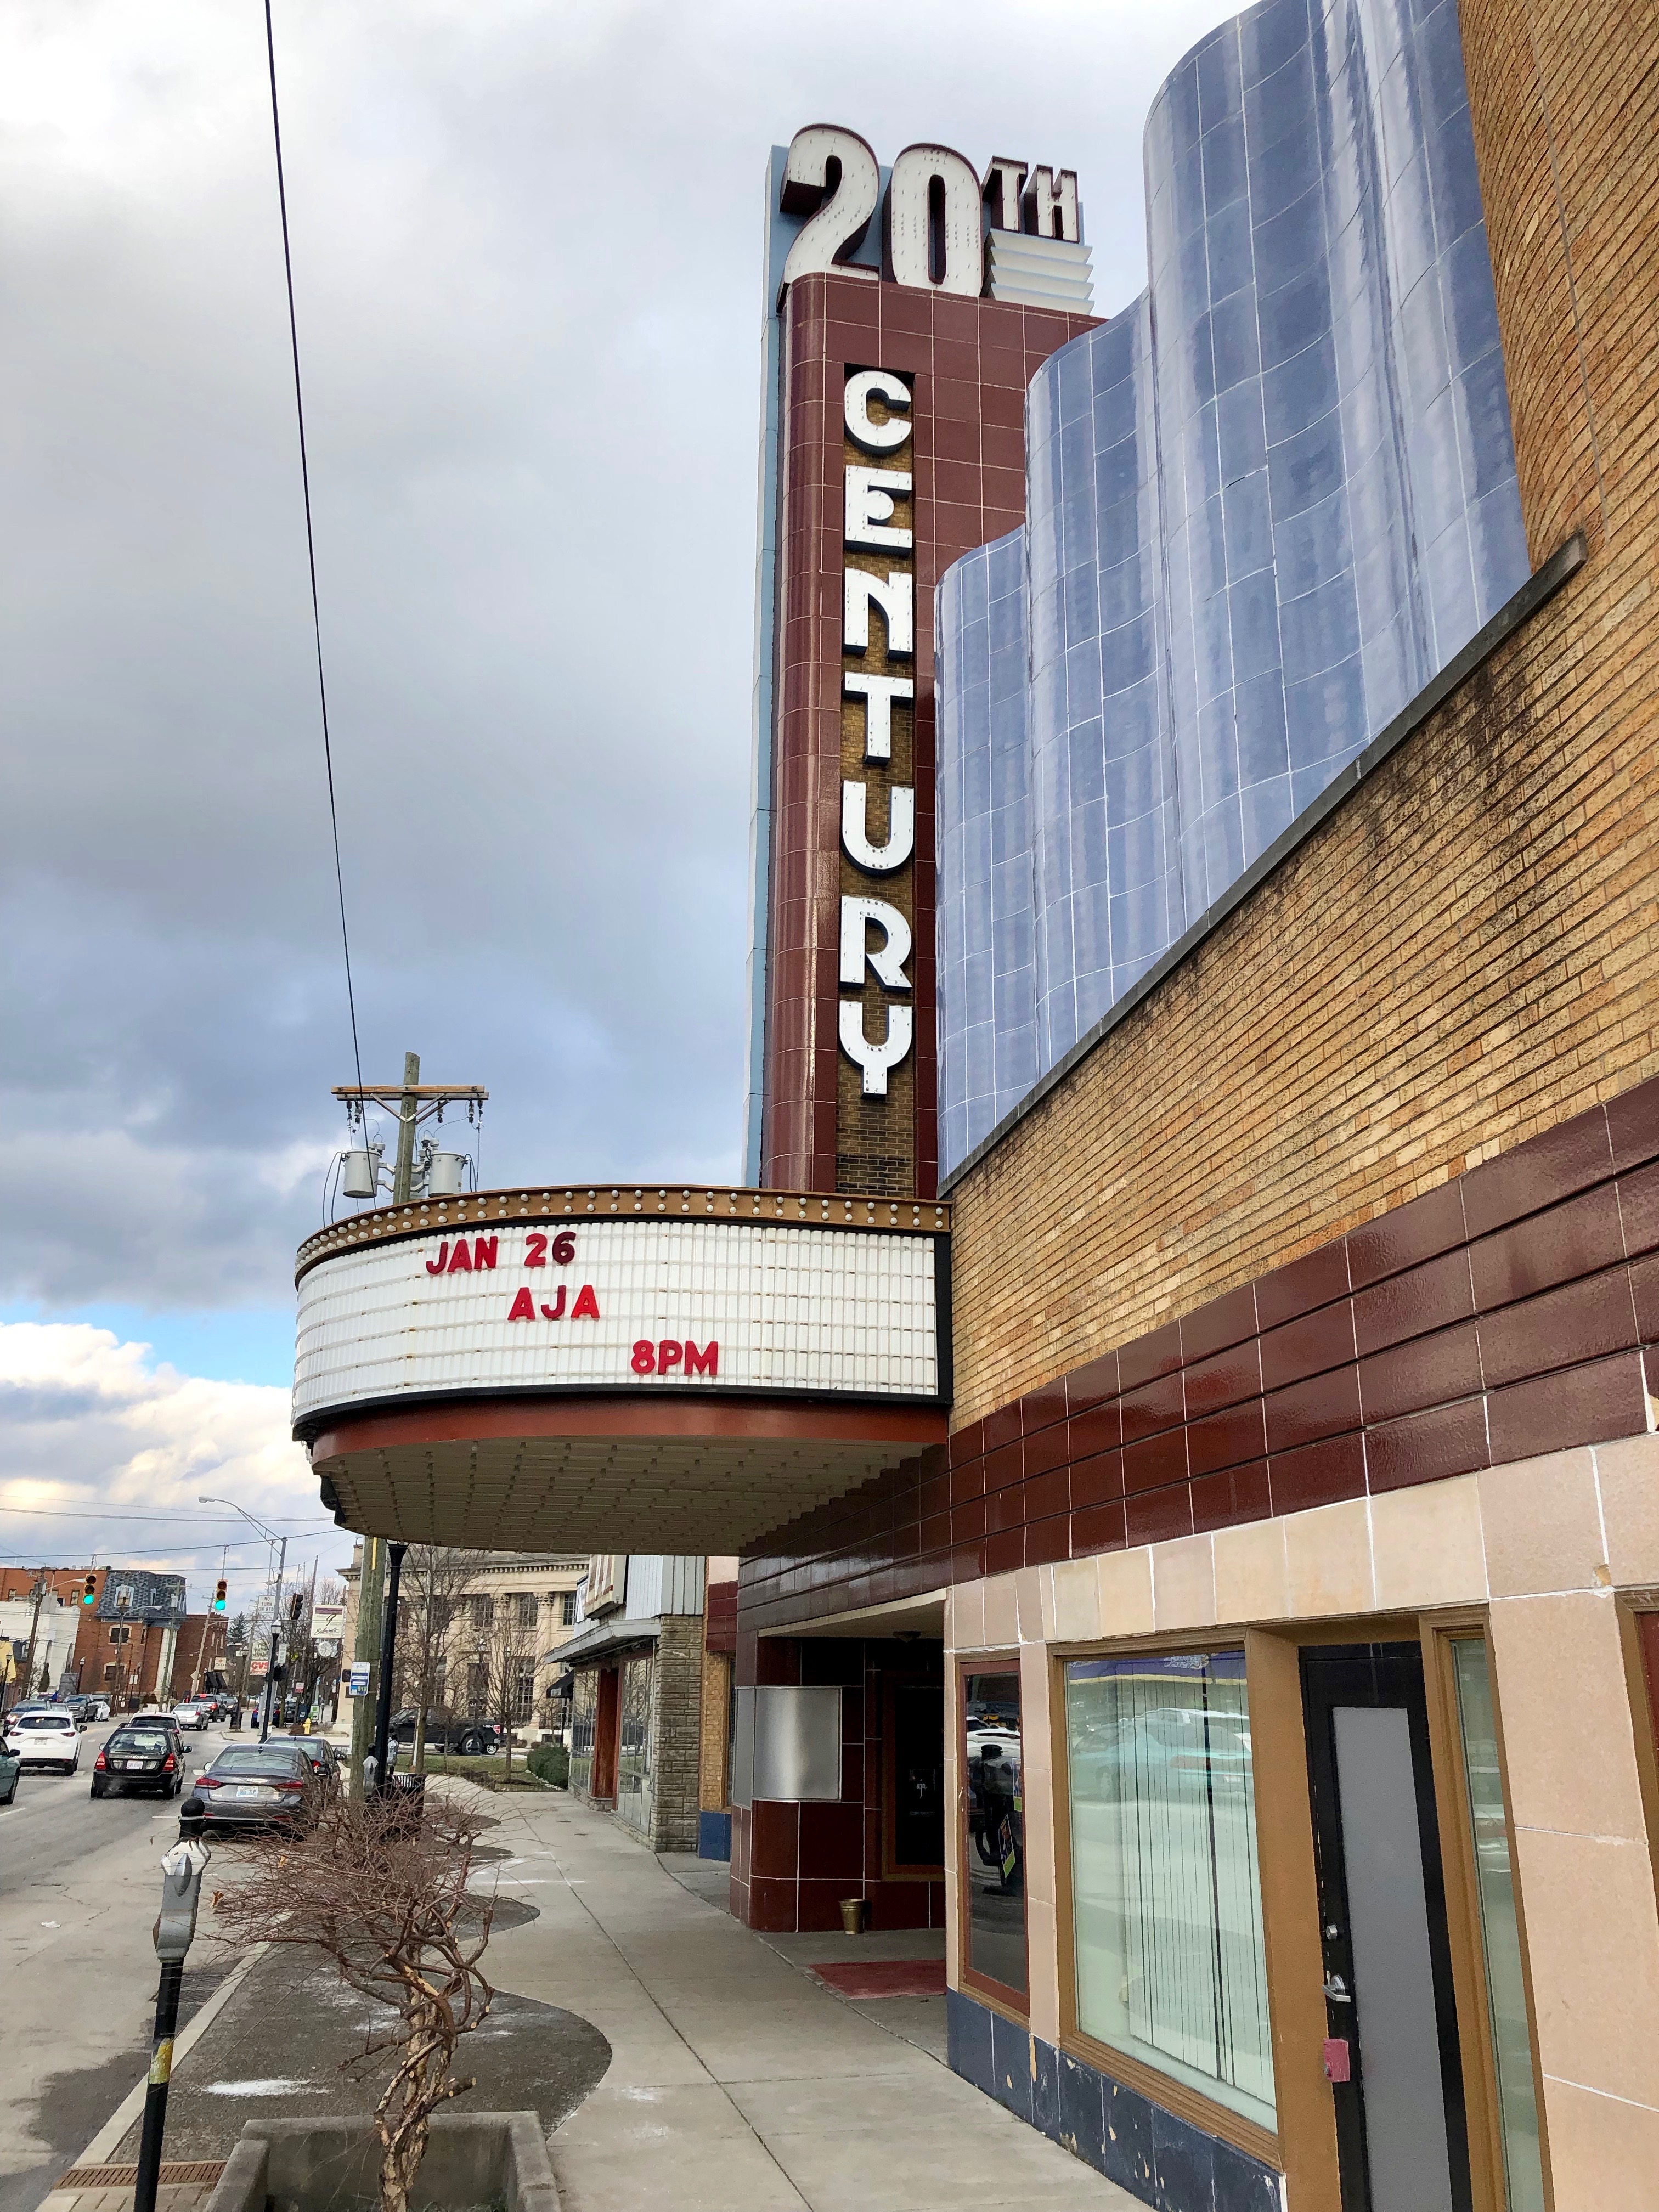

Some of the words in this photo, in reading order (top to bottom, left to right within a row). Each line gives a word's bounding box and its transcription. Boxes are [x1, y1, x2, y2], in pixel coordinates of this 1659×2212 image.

[778, 123, 1080, 307] 20TH
[839, 370, 915, 1096] CENTURY
[426, 1236, 498, 1274] JAN
[524, 1231, 576, 1267] 26
[508, 1284, 600, 1319] AJA
[631, 1340, 718, 1375] 8PM
